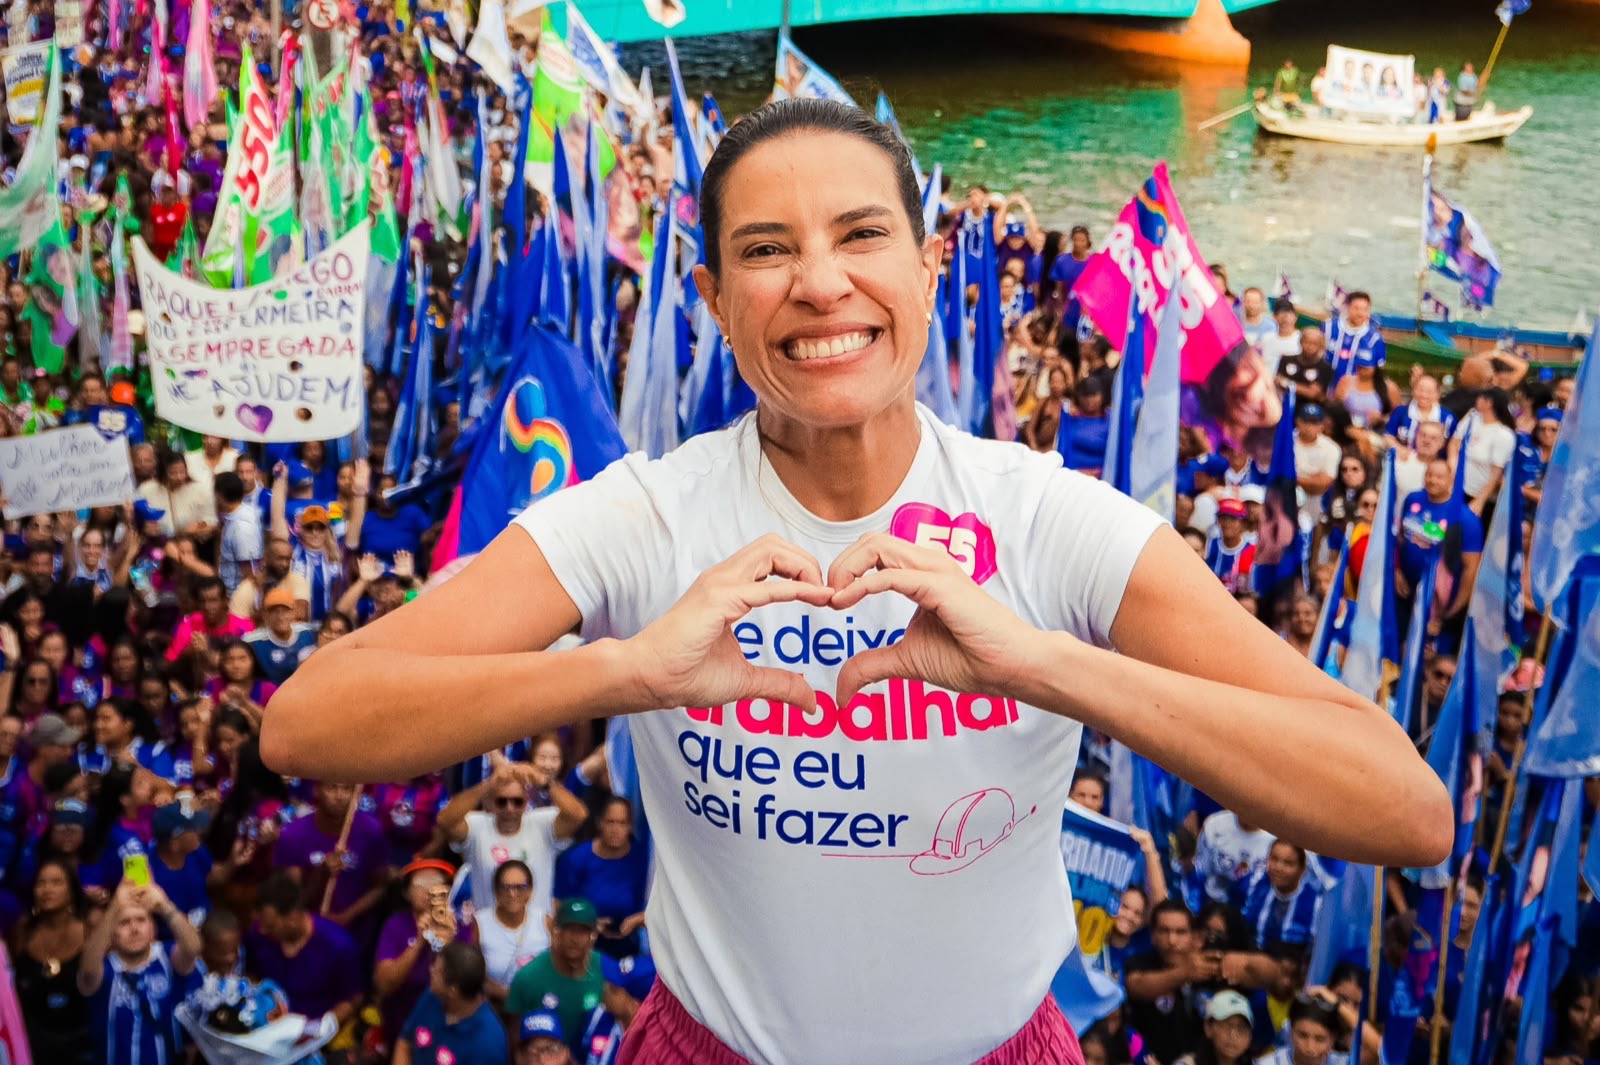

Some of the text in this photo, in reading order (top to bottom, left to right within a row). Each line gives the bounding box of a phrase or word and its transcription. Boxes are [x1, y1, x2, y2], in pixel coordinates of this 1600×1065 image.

[915, 522, 977, 577] 55
[734, 622, 763, 660] e
[678, 730, 866, 790] que eu
[684, 781, 909, 848] sei fazer
